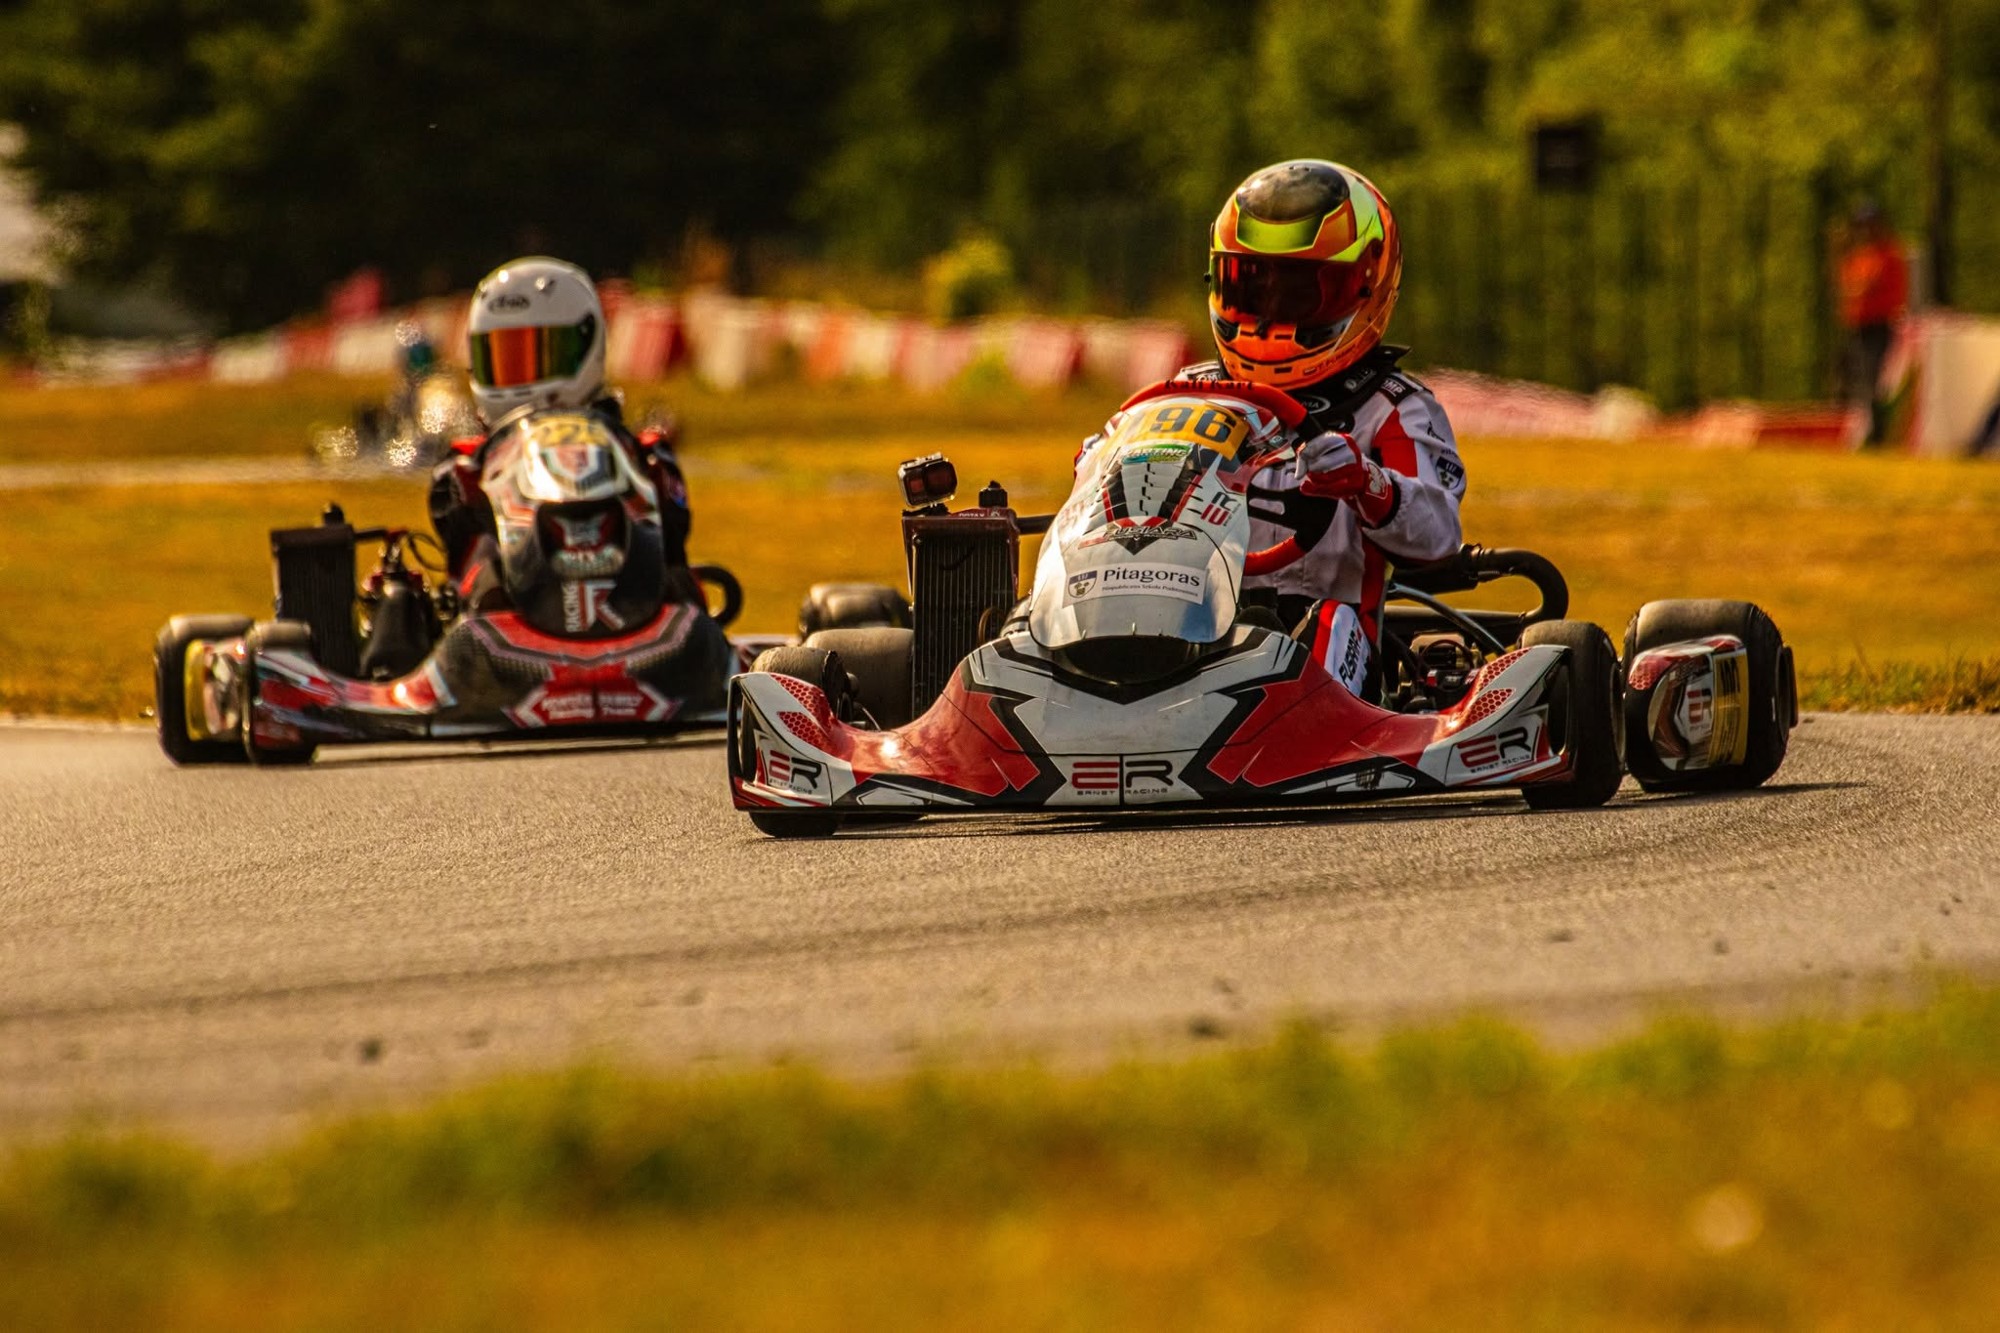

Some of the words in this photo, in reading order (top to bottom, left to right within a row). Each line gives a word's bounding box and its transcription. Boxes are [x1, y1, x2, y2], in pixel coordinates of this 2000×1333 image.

[1103, 566, 1200, 587] Pitagoras
[1456, 726, 1532, 768] ER
[769, 749, 822, 789] ER
[1071, 759, 1174, 789] ER
[1124, 787, 1168, 795] RACING
